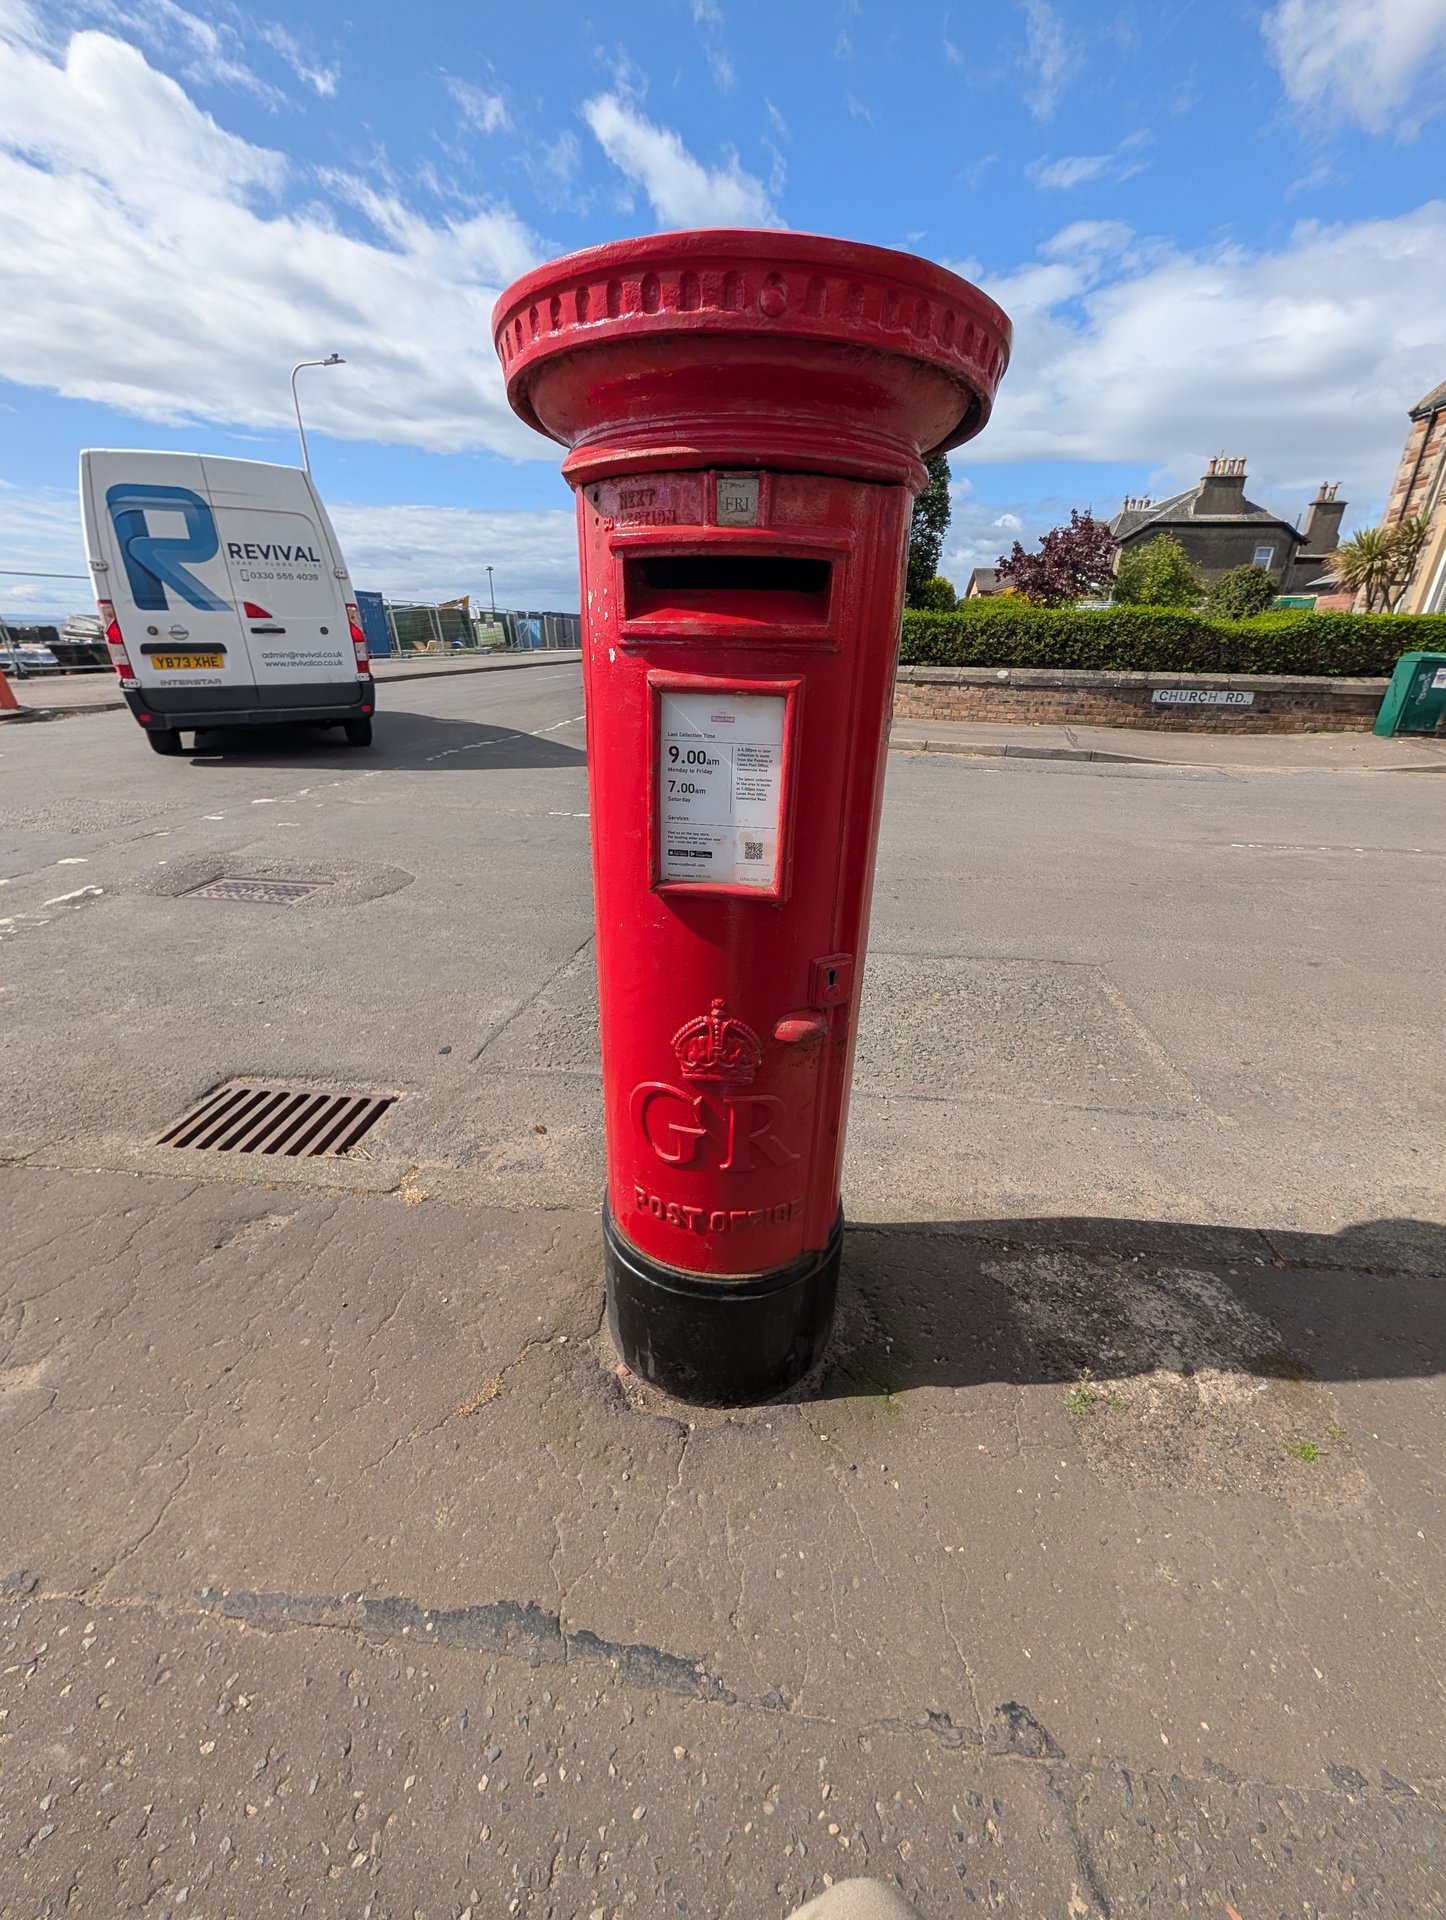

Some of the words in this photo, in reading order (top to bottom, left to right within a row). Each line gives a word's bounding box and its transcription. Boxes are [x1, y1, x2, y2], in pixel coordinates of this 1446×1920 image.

[618, 488, 656, 510] NEXT
[724, 496, 751, 511] FRI
[227, 543, 321, 562] REVIVAL
[250, 572, 274, 580] 0330
[276, 573, 294, 581] 555
[296, 573, 319, 581] 4039
[156, 656, 191, 668] YB73
[193, 655, 220, 668] XHE
[160, 678, 222, 686] INTERSTAR
[1159, 690, 1218, 702] CHURCH
[1225, 692, 1247, 703] RD.
[668, 745, 720, 765] 9.00am
[668, 780, 706, 794] 7.00am
[629, 1081, 801, 1171] GR
[634, 1185, 704, 1230] POST
[709, 1195, 804, 1232] OFFICE
